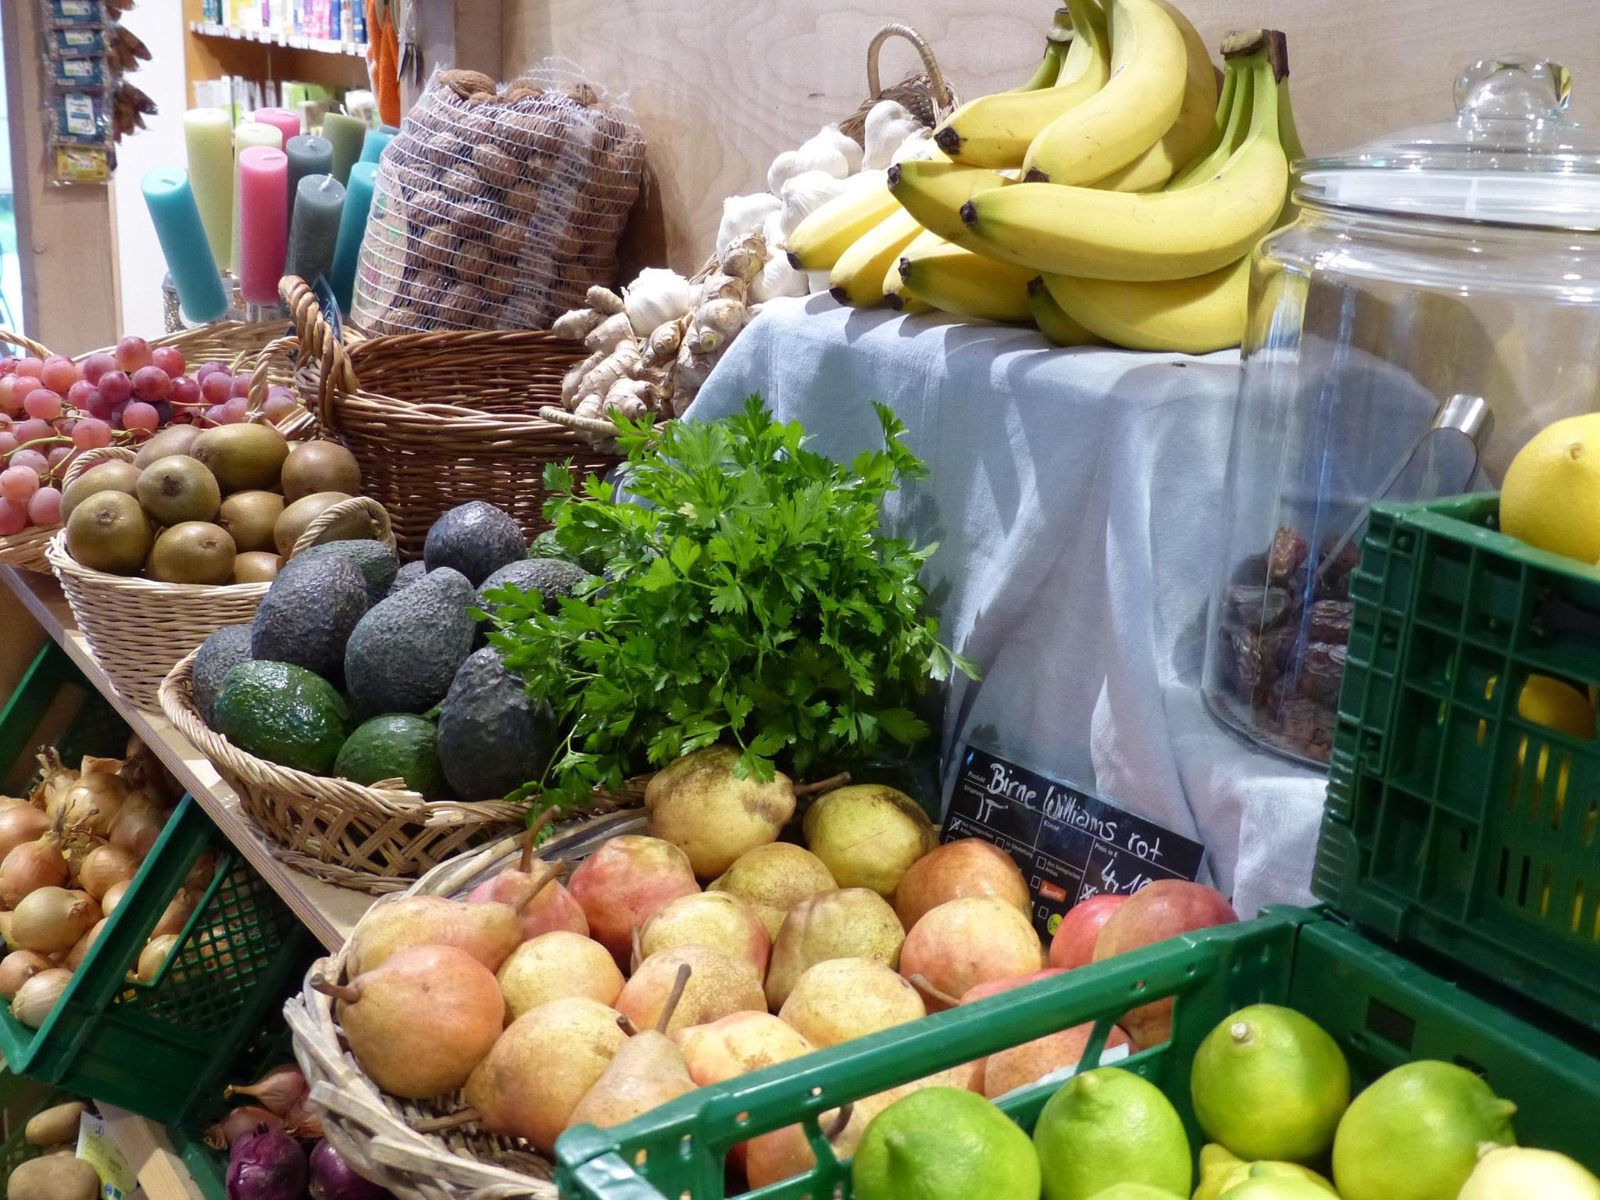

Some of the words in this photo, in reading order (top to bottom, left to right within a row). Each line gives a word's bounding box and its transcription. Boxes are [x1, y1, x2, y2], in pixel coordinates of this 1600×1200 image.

[987, 762, 1037, 810] Birne
[1043, 785, 1118, 842] Williams
[1128, 831, 1164, 862] rot
